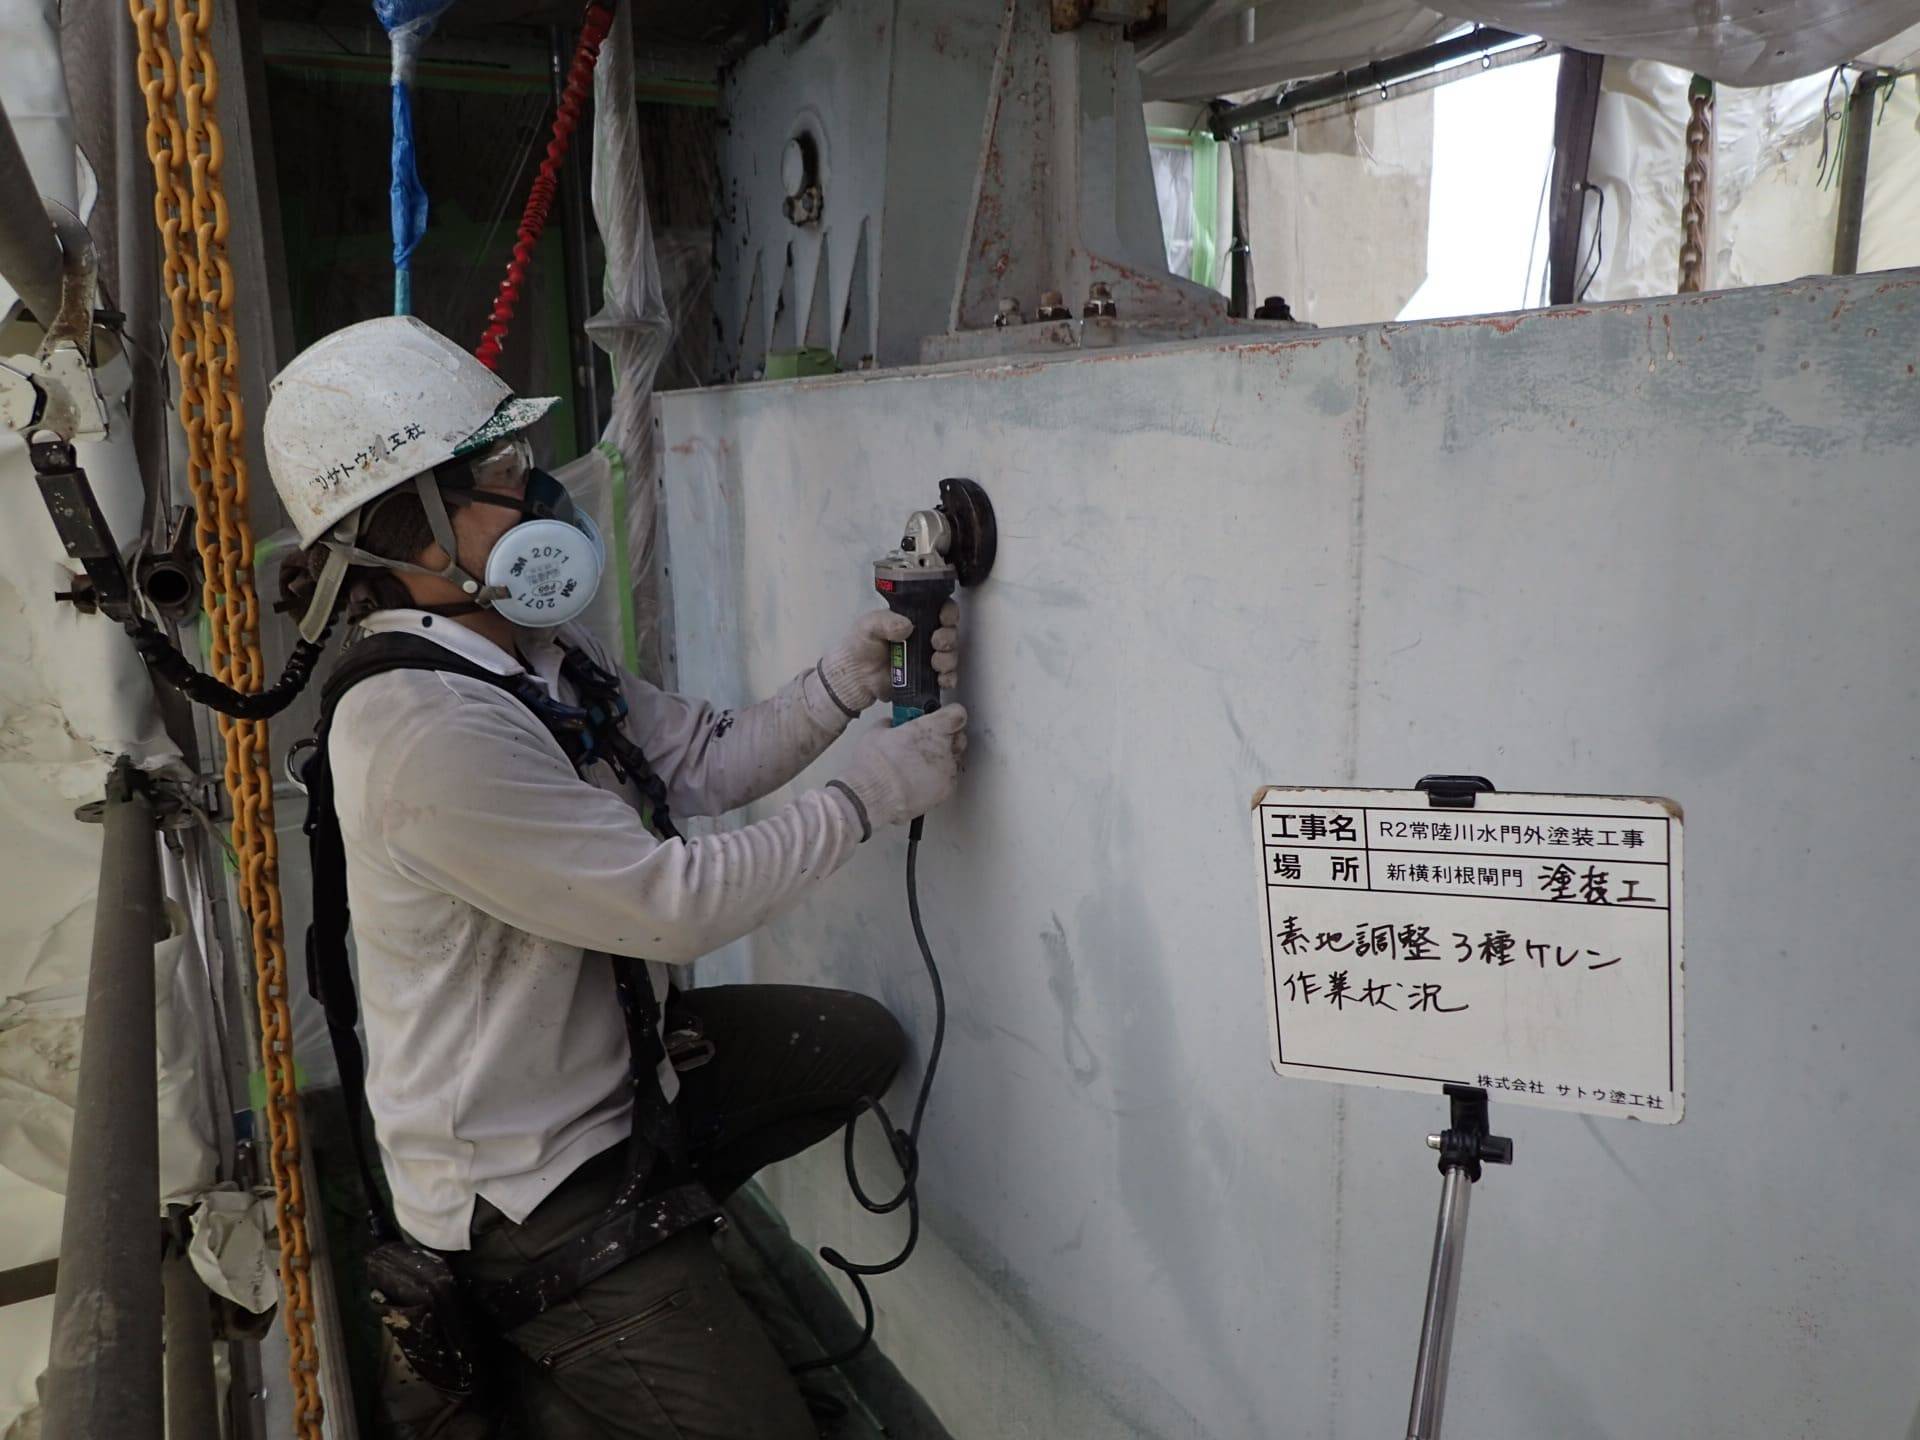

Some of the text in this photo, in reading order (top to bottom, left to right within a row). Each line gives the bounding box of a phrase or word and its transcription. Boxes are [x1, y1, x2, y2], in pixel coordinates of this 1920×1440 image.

[532, 547, 569, 563] 2071
[510, 556, 528, 577] 3M
[560, 578, 577, 598] 3M
[518, 593, 555, 609] 2071
[1271, 814, 1357, 842] 工事名
[1380, 821, 1645, 848] R2常陸川水門外塗装工事
[1283, 971, 1469, 1012] 作業状況
